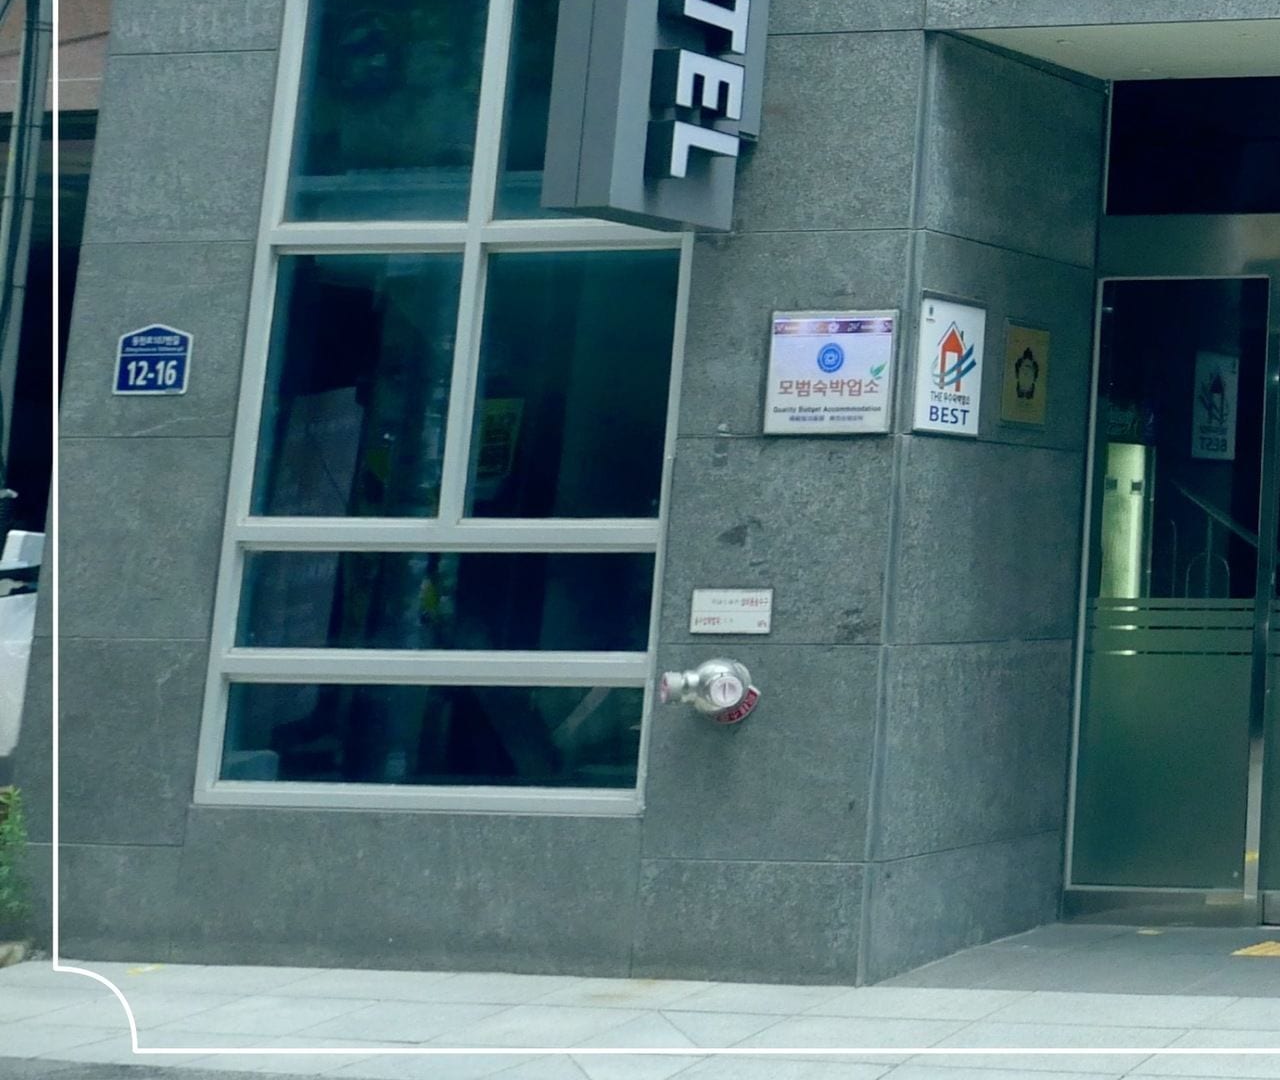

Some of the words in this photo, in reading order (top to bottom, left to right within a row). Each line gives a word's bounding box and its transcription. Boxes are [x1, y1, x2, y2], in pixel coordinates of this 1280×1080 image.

[127, 360, 178, 386] 12-16
[778, 379, 880, 397] 모범숙박업소
[929, 405, 970, 426] BEST
